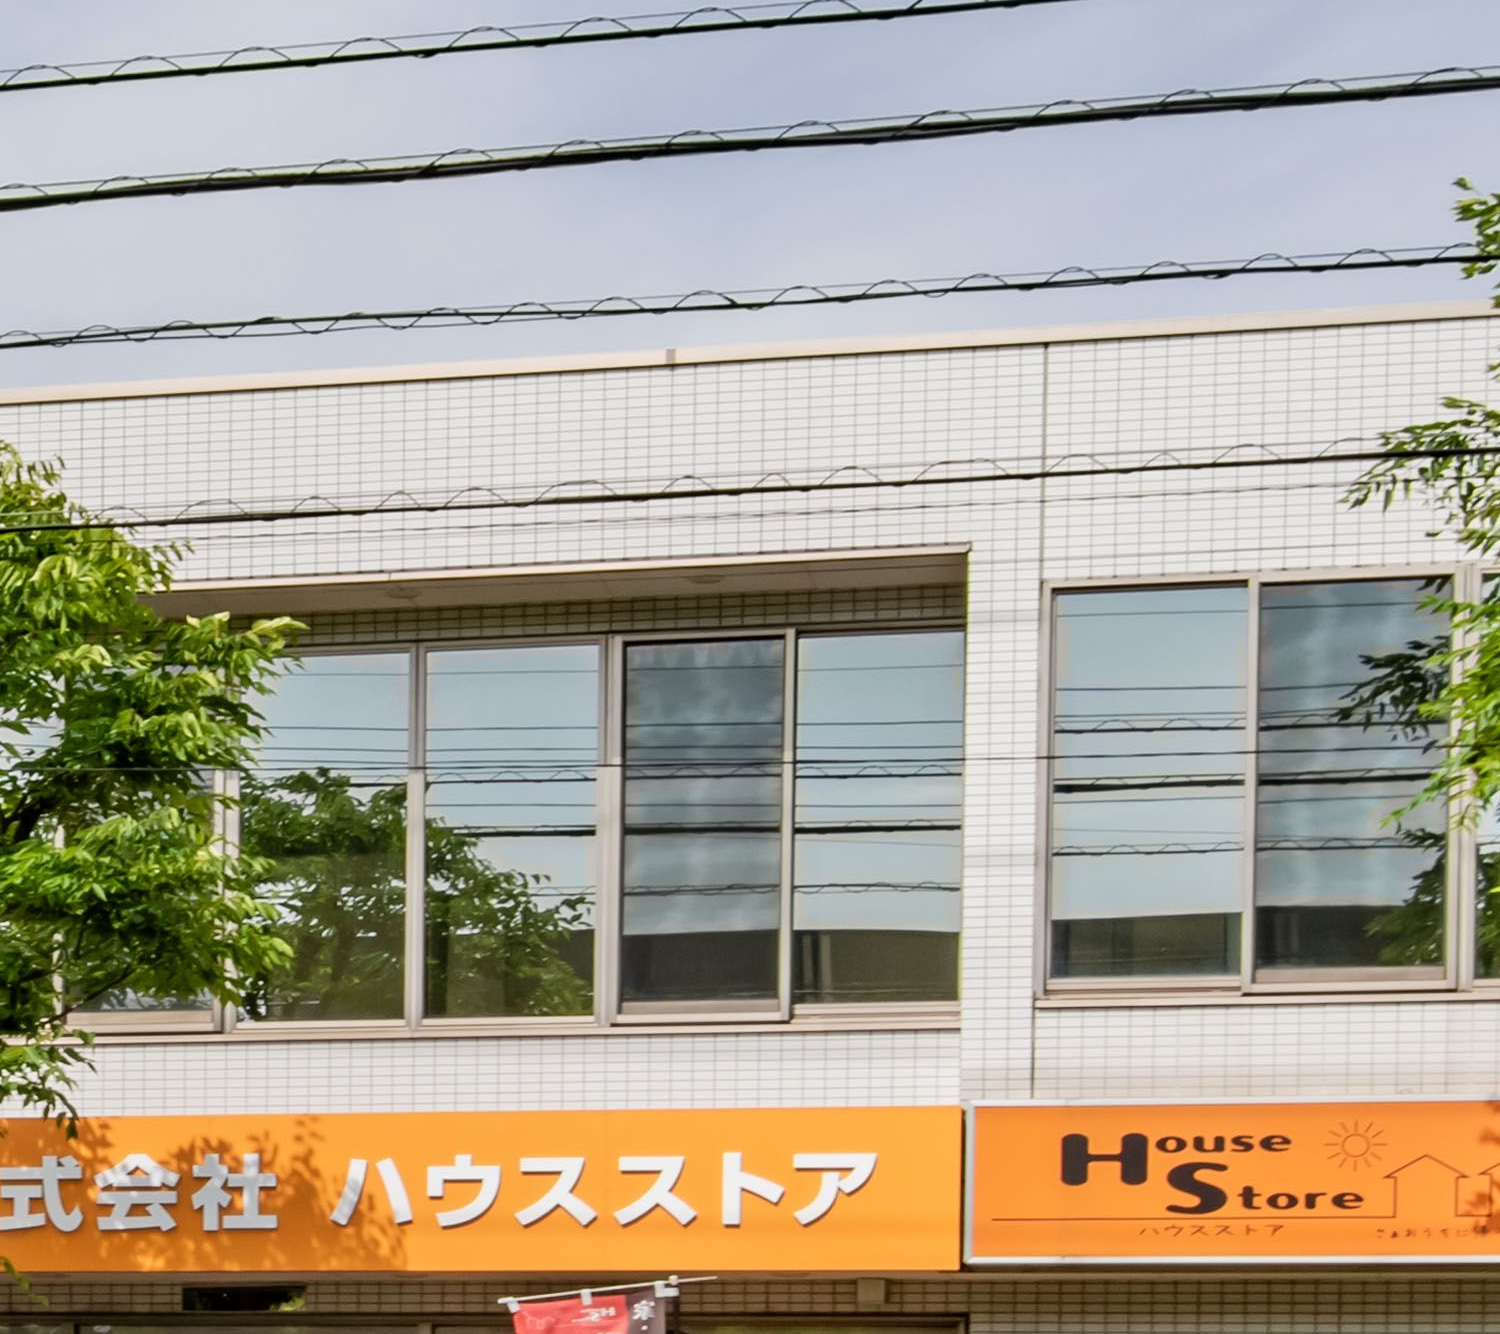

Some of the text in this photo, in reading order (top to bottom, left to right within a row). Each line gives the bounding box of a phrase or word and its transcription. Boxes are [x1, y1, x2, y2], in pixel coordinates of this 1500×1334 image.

[1061, 1131, 1292, 1186] House
[329, 1150, 879, 1231] ハウスストア
[1166, 1162, 1365, 1215] Store
[1138, 1223, 1285, 1237] ハウスストア
